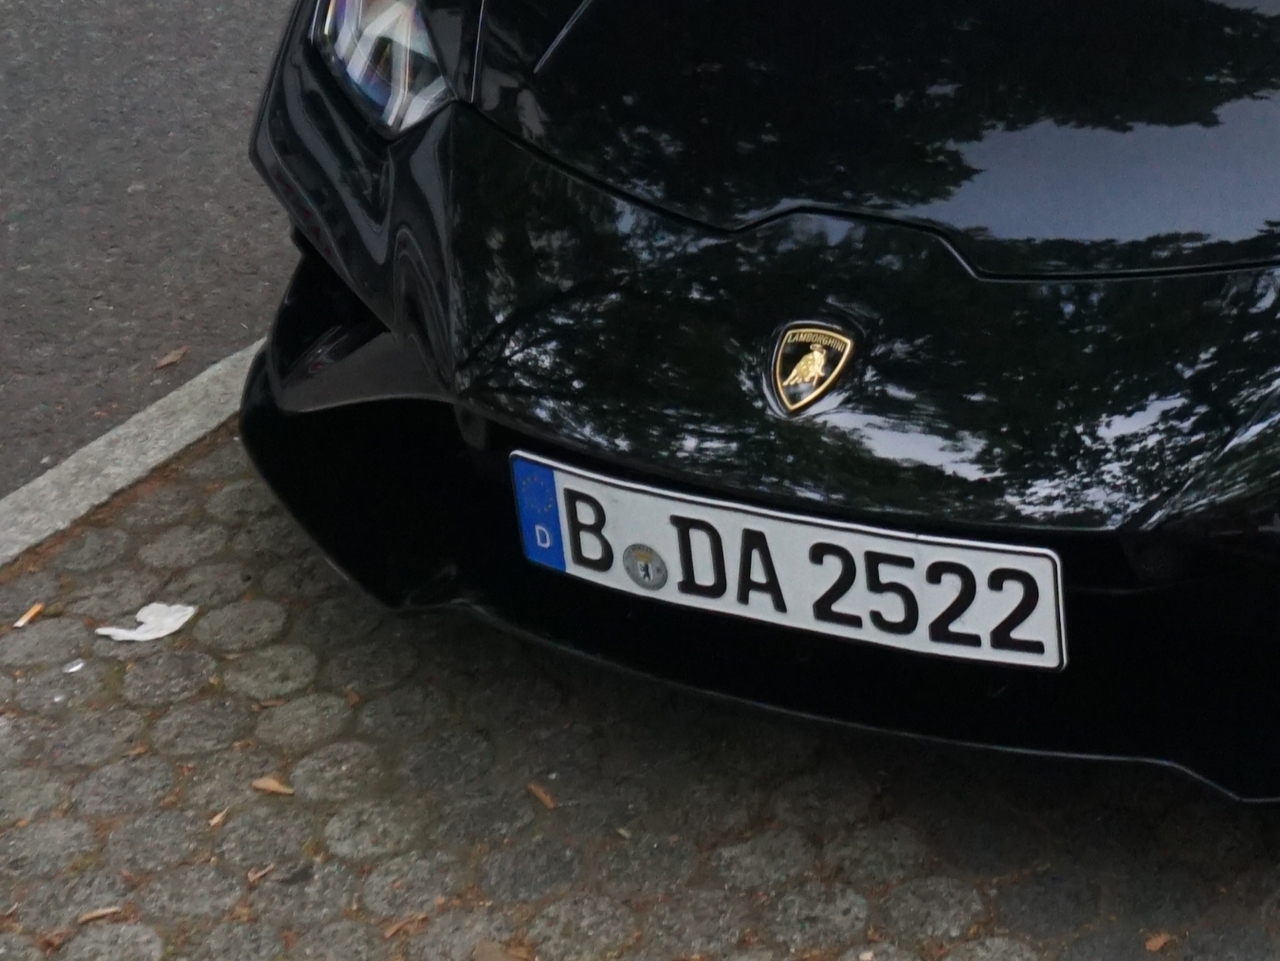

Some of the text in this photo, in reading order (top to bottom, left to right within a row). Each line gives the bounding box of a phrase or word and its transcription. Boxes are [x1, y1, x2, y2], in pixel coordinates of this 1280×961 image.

[787, 332, 846, 352] LAMBORGHINI
[535, 525, 550, 548] D
[563, 487, 1046, 655] B DA 2522
